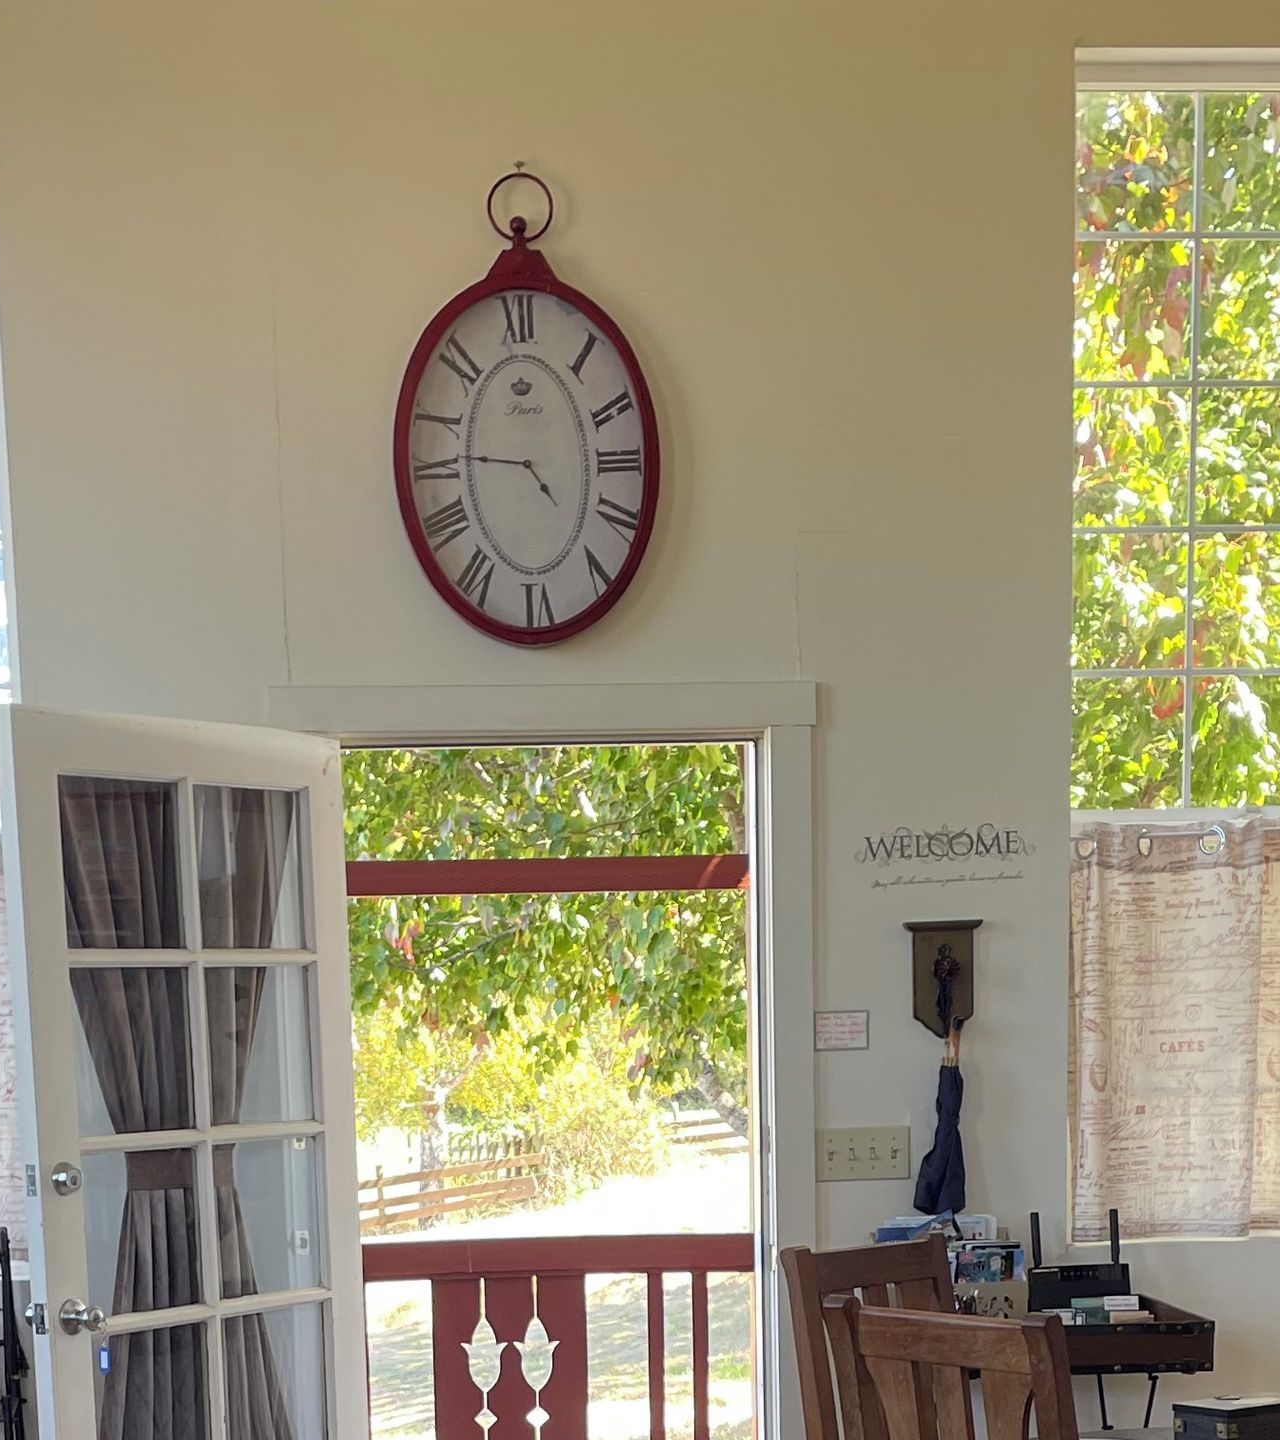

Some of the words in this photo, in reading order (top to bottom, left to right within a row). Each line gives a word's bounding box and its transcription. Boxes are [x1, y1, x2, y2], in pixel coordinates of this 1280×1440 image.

[496, 293, 538, 345] XII
[438, 328, 484, 398] XI
[412, 400, 463, 440] X
[504, 401, 544, 417] Paris
[588, 384, 635, 433] II
[412, 453, 461, 483] IX
[595, 445, 642, 477] III
[521, 582, 556, 628] VI
[863, 830, 1020, 861] WELCOME
